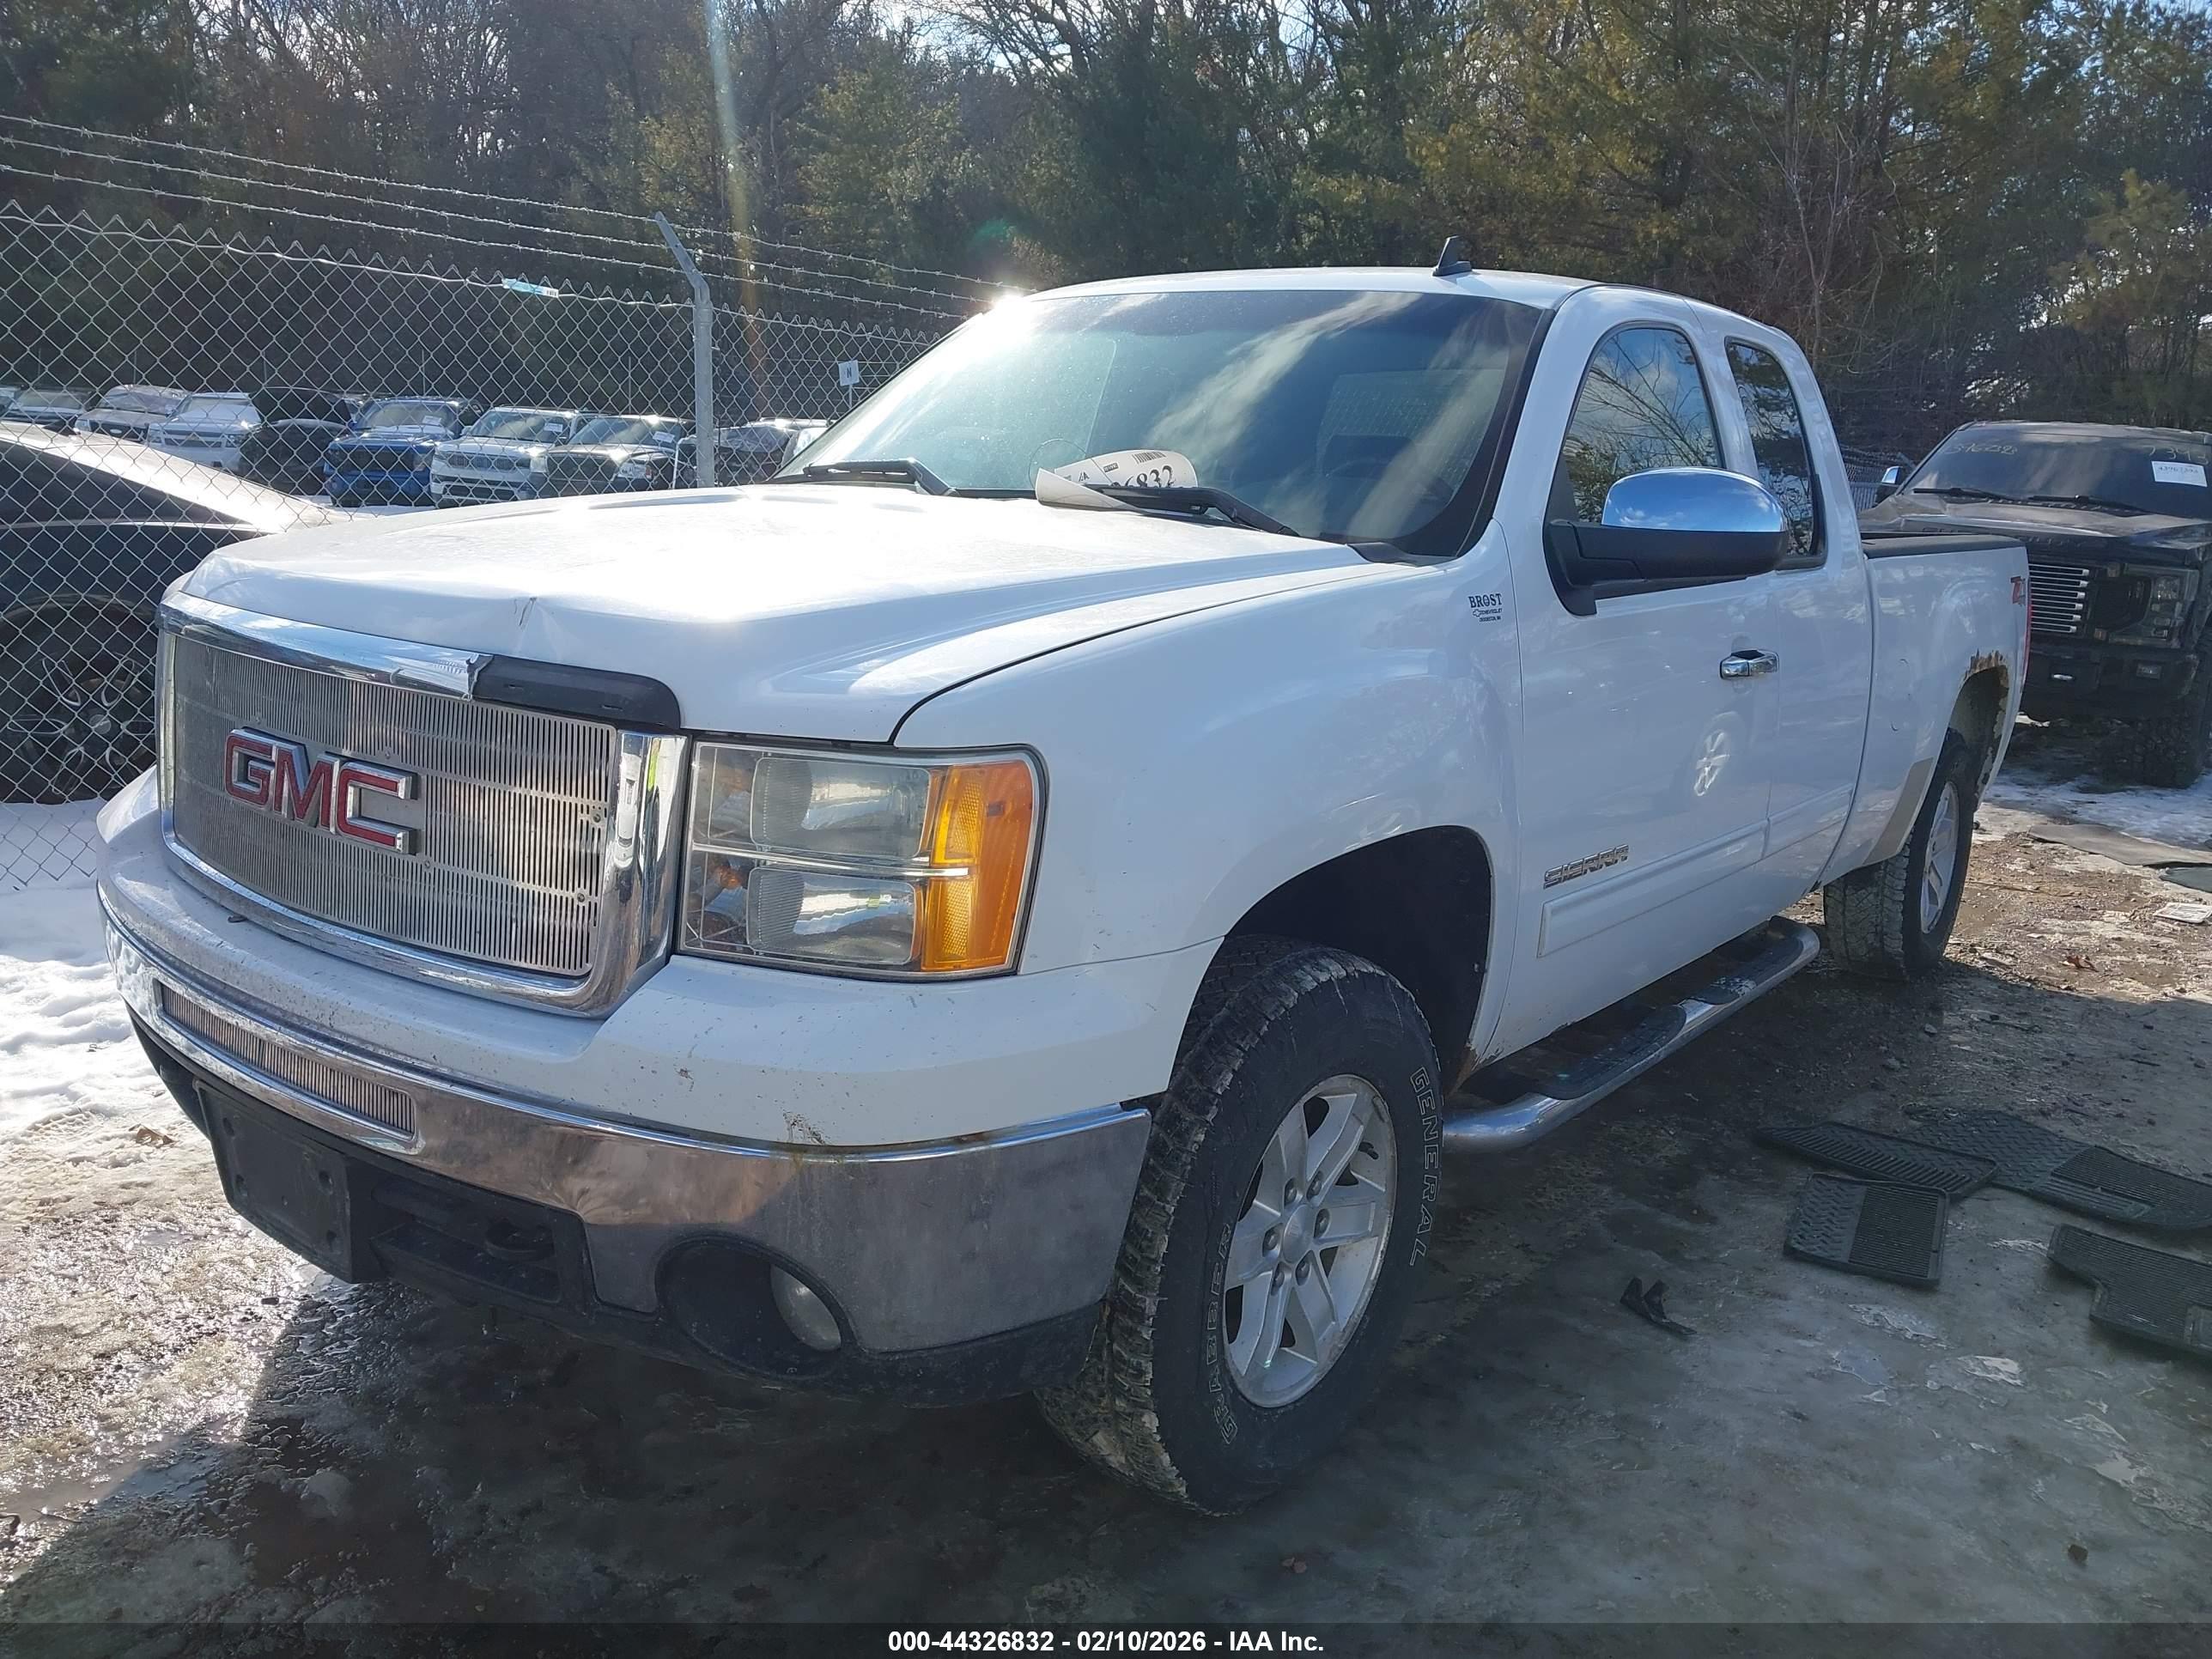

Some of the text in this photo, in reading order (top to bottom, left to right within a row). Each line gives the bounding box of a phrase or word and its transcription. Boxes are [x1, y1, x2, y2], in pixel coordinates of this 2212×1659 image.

[1468, 593, 1502, 608] BROST
[224, 728, 413, 854] GMC
[1410, 1066, 1439, 1267] GENERAL
